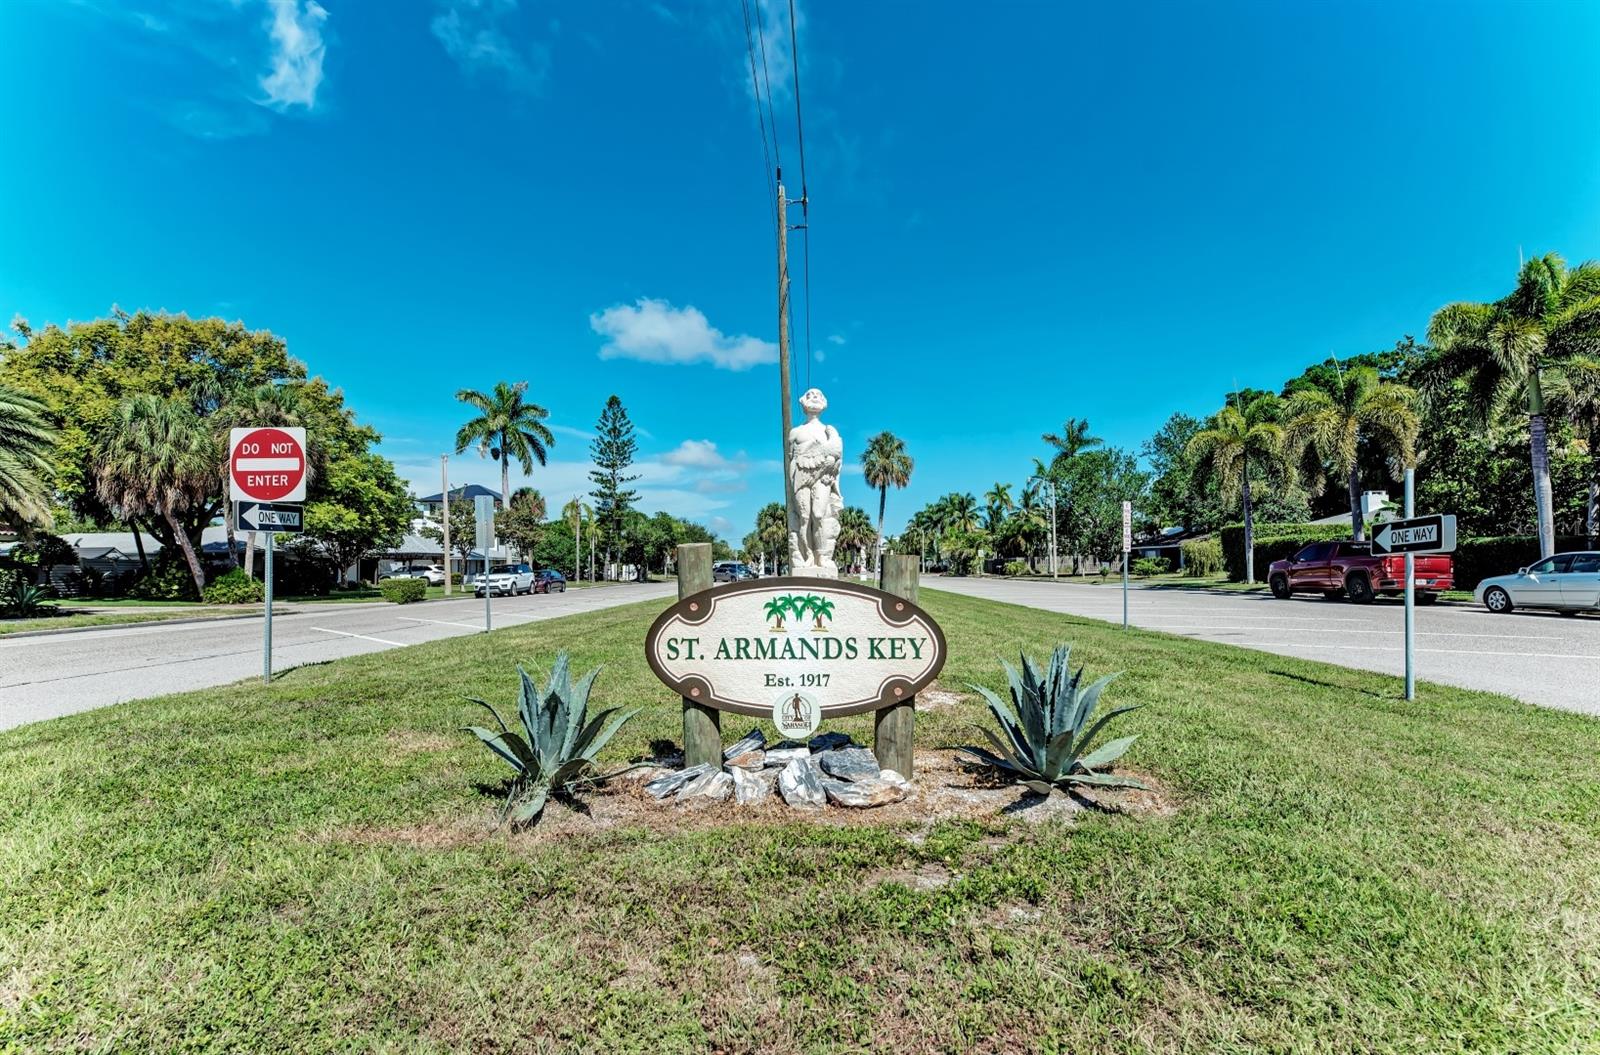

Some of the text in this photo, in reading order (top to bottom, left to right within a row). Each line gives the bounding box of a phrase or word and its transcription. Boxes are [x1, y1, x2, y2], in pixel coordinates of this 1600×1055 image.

[242, 442, 293, 454] DO NOT
[247, 475, 288, 486] ENTER
[258, 511, 297, 524] ONE WAY
[1390, 526, 1434, 544] ONE WAY
[666, 637, 927, 660] ST. ARMANDS KEY
[763, 673, 830, 688] Est. 1917
